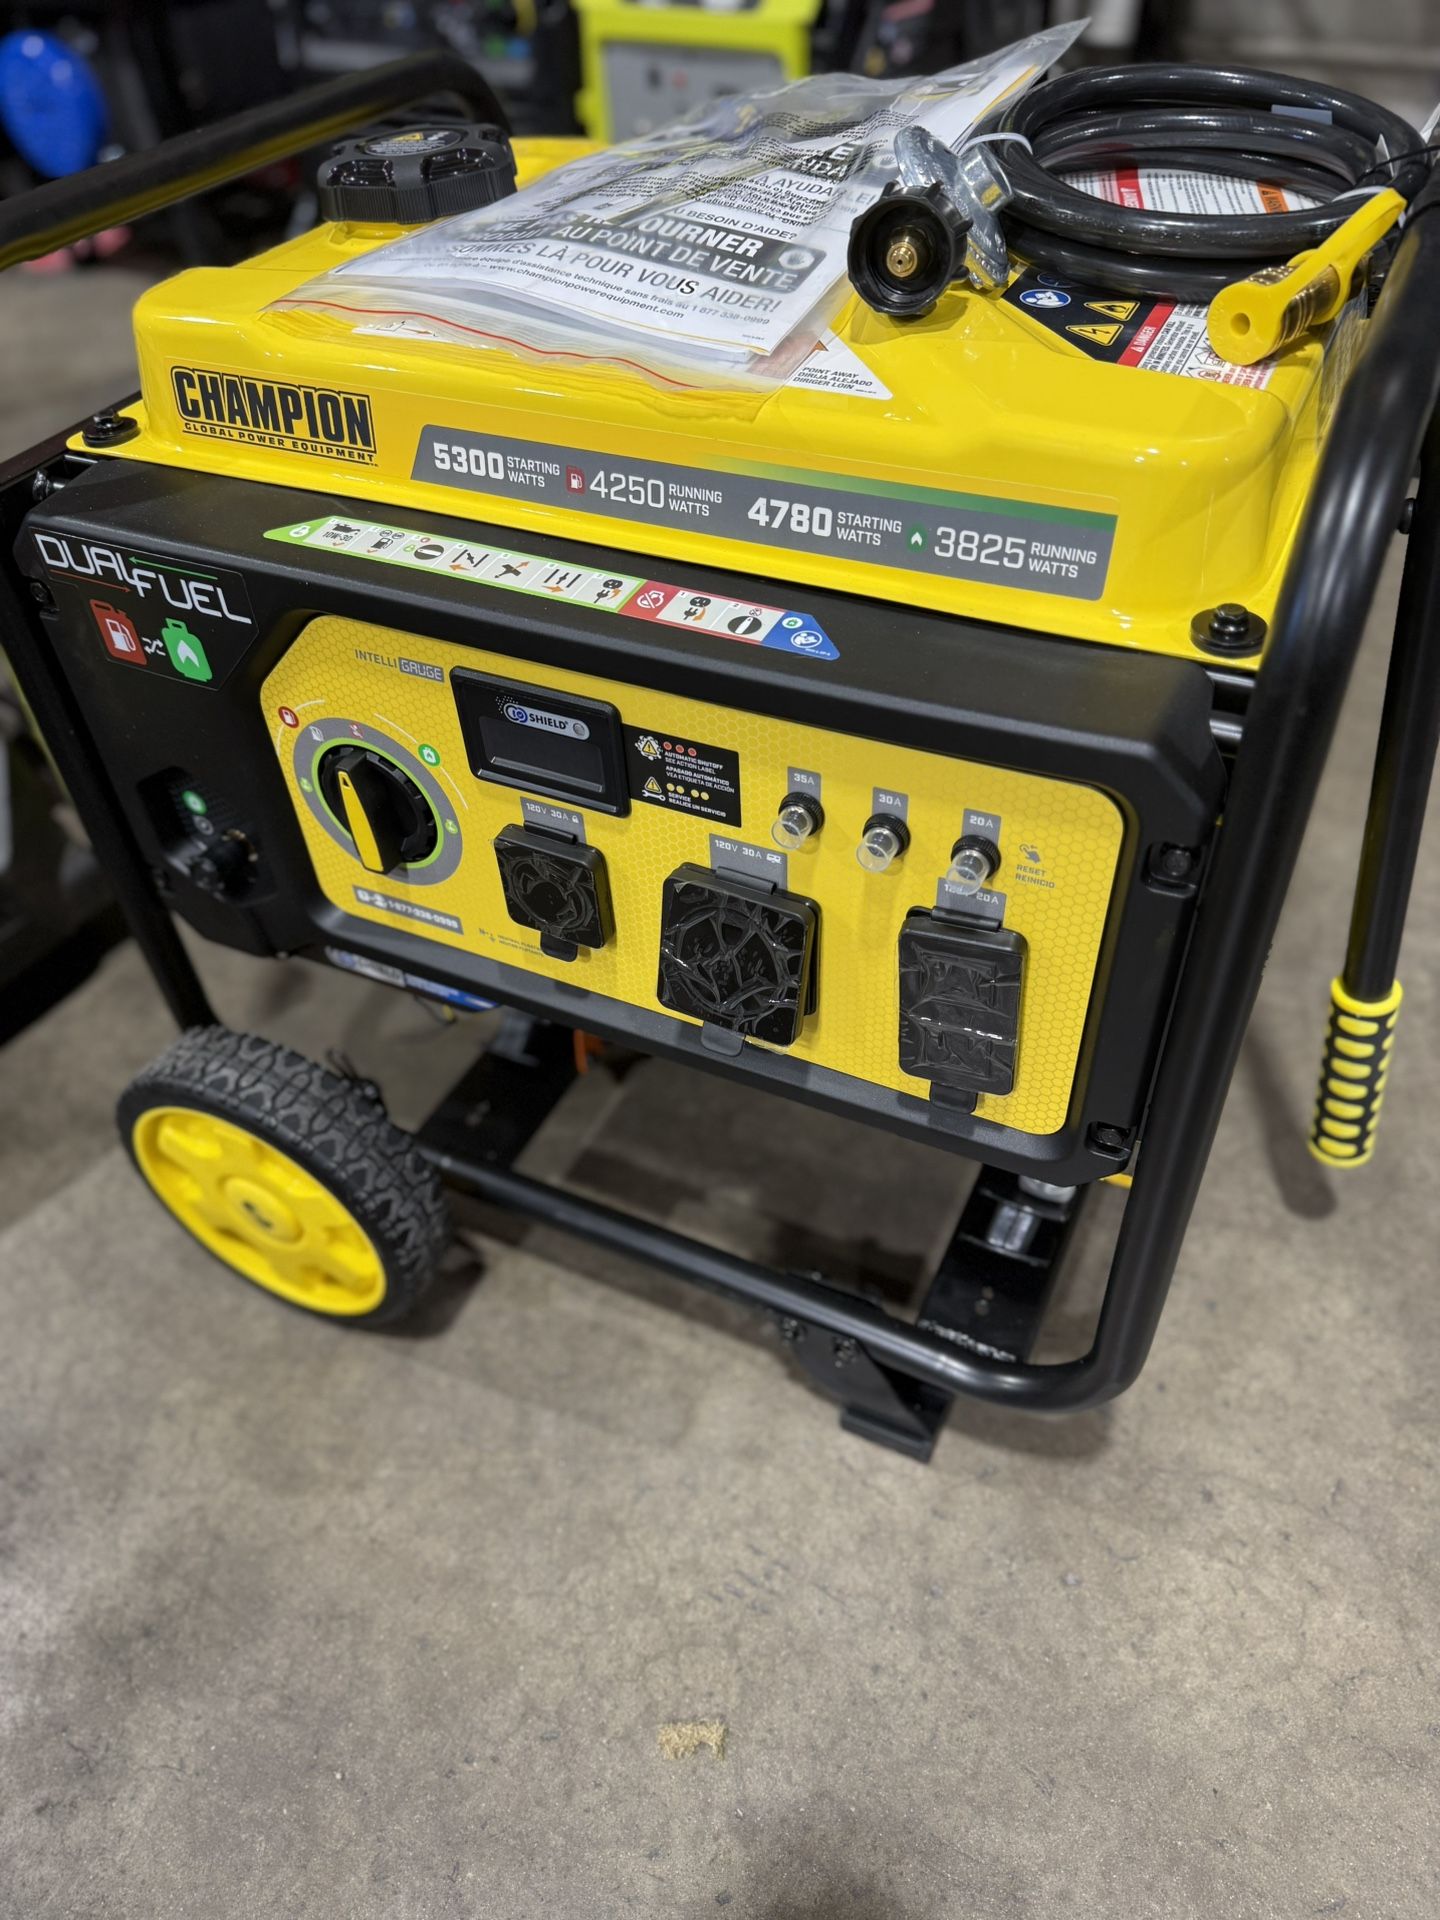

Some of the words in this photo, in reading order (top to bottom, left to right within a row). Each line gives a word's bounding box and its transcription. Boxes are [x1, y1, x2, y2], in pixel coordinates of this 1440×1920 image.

[683, 208, 740, 228] BESOIN
[743, 222, 798, 240] D'AIDE?
[550, 225, 592, 240] AU
[588, 228, 673, 258] POINT
[668, 246, 707, 268] DE
[708, 255, 799, 290] VENTE
[511, 258, 573, 278] d'assistance
[573, 272, 623, 292] technique
[624, 287, 650, 300] sans
[650, 293, 674, 308] frais
[674, 302, 690, 311] au
[536, 244, 570, 262] LÀ
[569, 252, 635, 279] POUR
[637, 268, 700, 296] VOUS
[700, 286, 784, 314] AIDER!
[489, 264, 685, 319] www.championpowerequipment.com
[798, 371, 828, 381] DIRIJA
[830, 376, 873, 387] ALEJADO
[802, 366, 830, 376] POINT
[831, 370, 860, 379] AWAY
[793, 376, 830, 387] DIRIGER
[831, 381, 855, 390] LOIN
[173, 369, 374, 450] CHAMPION
[184, 421, 234, 439] GLOBAL
[238, 431, 286, 448] POWER
[291, 440, 376, 463] EQUIPMENT
[433, 441, 505, 480] 5300
[506, 456, 561, 476] STARTING
[507, 470, 546, 488] WATTS
[589, 470, 665, 508] 4250
[668, 484, 723, 504] RUNNING
[668, 499, 711, 517] WATTS
[747, 497, 833, 538] 4780
[837, 511, 902, 534] STARTING
[836, 527, 882, 547] WATTS
[934, 526, 1027, 569] 3825
[1030, 541, 1098, 565] RUNNING
[1028, 558, 1079, 579] WATTS
[529, 713, 567, 730] SHIELD
[665, 751, 697, 764] AUTOMATIC
[697, 759, 724, 770] SHUTOFF
[665, 757, 676, 765] SEE
[676, 760, 698, 770] ACTION
[698, 765, 716, 775] LABEL
[665, 766, 693, 778] APAGADO
[693, 771, 730, 786] AUTOMÁTICO
[666, 771, 678, 779] VEA
[678, 774, 705, 786] ETIQUETA
[713, 783, 735, 794] ACCIÓN
[793, 772, 815, 786] 35A
[668, 792, 692, 802] SERVICE
[878, 793, 902, 807] 30A
[525, 803, 547, 815] 120V
[550, 809, 569, 821] 30A
[668, 799, 692, 809] REALICE
[700, 806, 727, 818] SERVICIO
[969, 815, 994, 829] 20A
[714, 839, 738, 853] 120V
[742, 847, 762, 859] 30A
[1016, 863, 1047, 877] RESET
[1015, 872, 1056, 889] REINICIO
[976, 891, 999, 905] 20A
